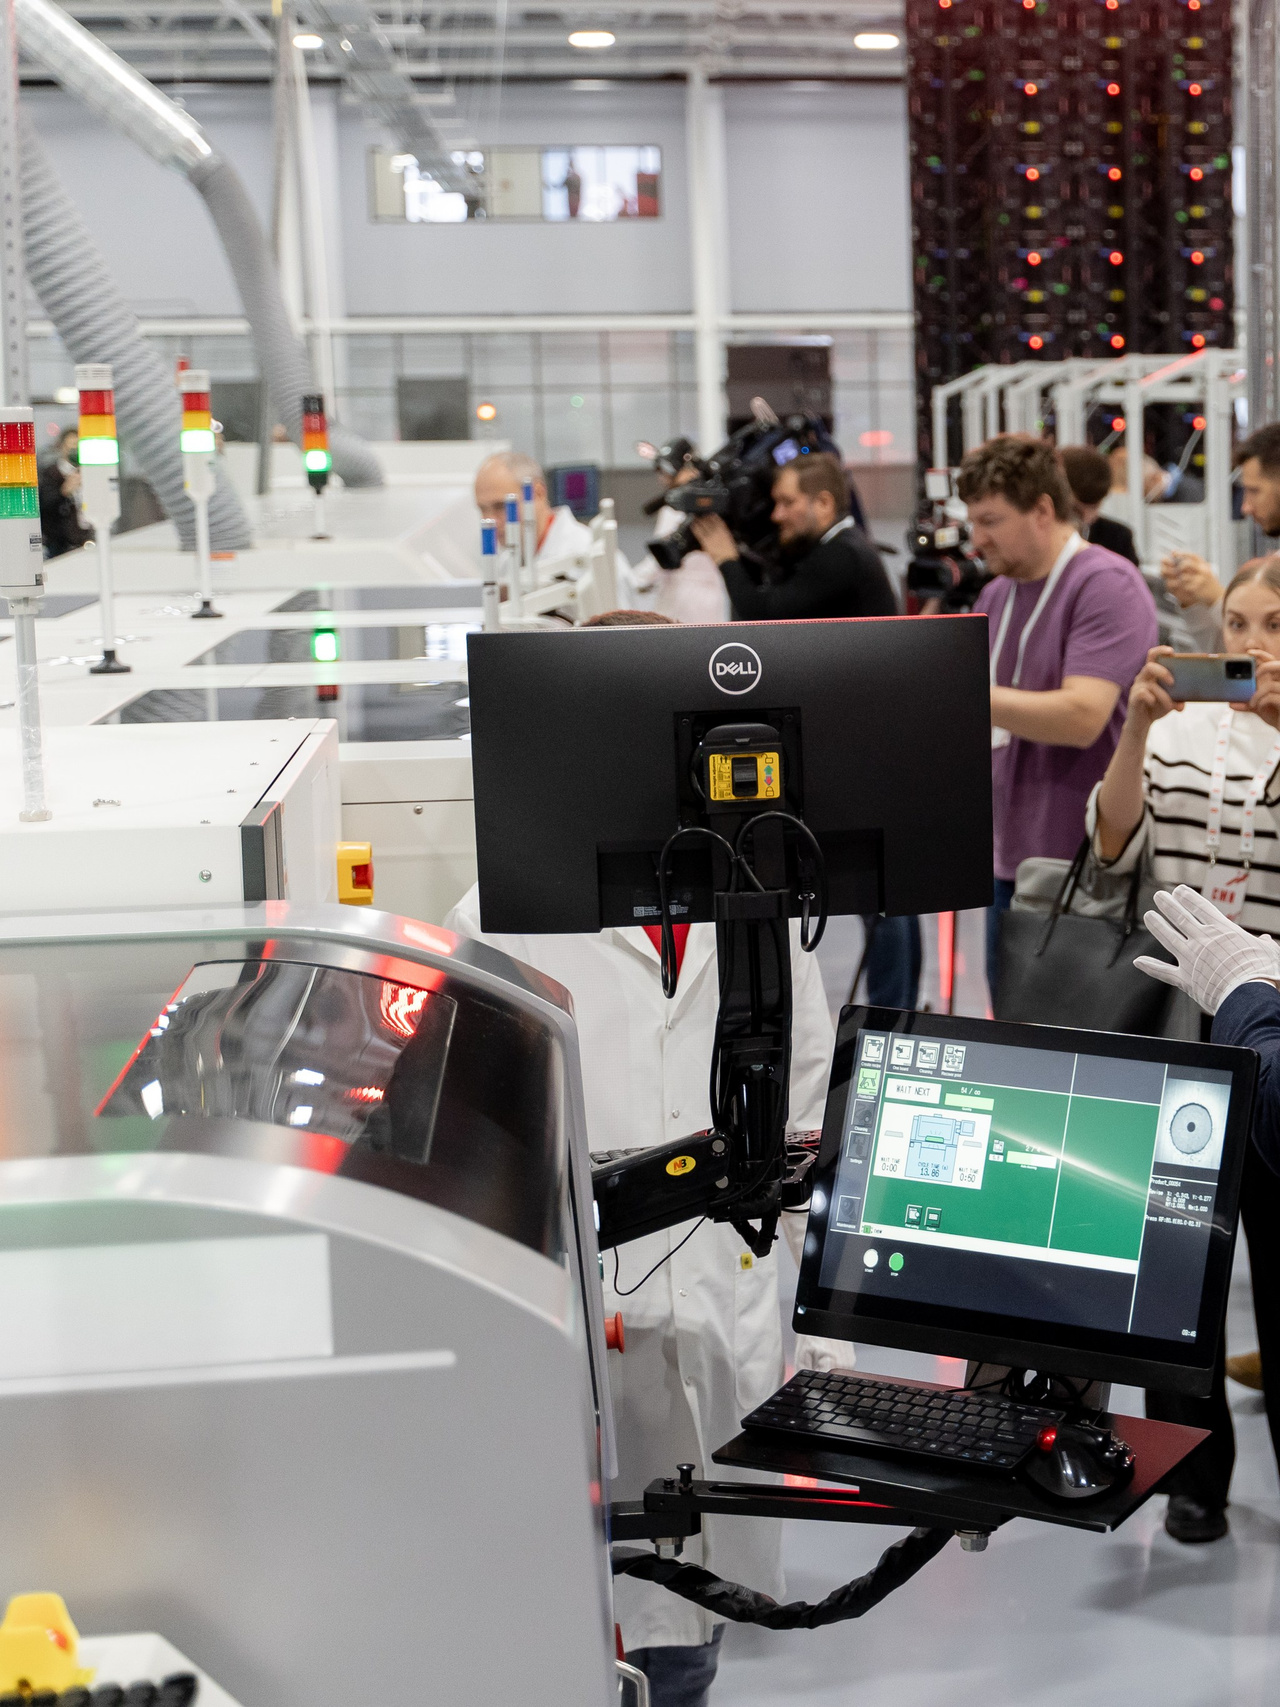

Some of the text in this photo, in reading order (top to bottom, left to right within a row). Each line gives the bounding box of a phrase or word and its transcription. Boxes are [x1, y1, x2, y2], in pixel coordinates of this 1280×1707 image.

[715, 661, 756, 676] DELL
[896, 1085, 931, 1096] WAIT NEXT
[882, 1162, 898, 1173] 0:00
[920, 1168, 940, 1178] 13.86
